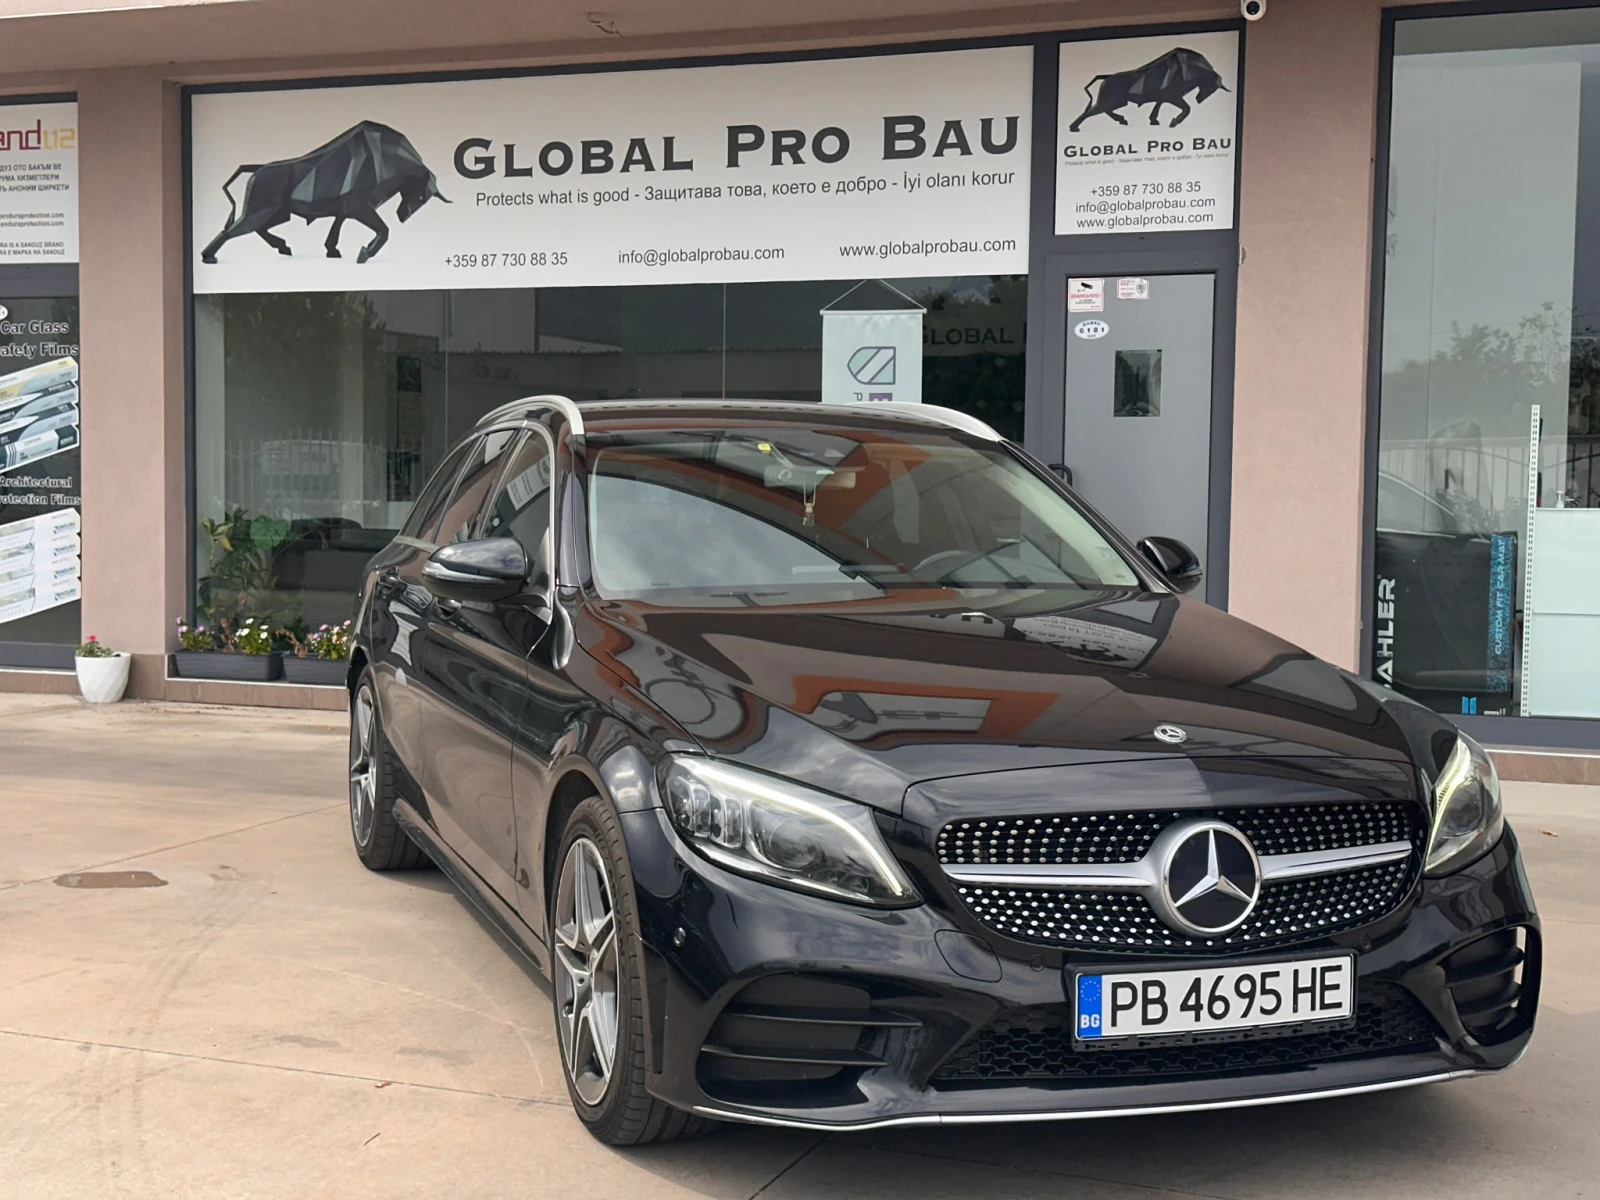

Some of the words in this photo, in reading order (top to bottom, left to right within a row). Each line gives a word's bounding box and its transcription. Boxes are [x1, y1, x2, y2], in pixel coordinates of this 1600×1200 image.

[454, 136, 694, 180] GLOBAL
[726, 124, 850, 168] PRO
[882, 114, 1020, 160] BAU
[1064, 144, 1137, 158] GLOBAL
[1148, 140, 1184, 153] PRO
[1192, 138, 1231, 150] BAU
[476, 190, 534, 207] Protects
[538, 189, 572, 204] what
[577, 189, 588, 203] is
[593, 187, 629, 206] good
[644, 186, 721, 202] Защитава
[728, 183, 766, 198] това,
[772, 180, 816, 196] което
[821, 181, 831, 193] е
[836, 176, 887, 195] добро
[972, 170, 1015, 186] korur
[1090, 185, 1119, 197] +359
[1123, 185, 1137, 196] 87
[1142, 183, 1164, 194] 730
[1167, 182, 1182, 193] 88
[1186, 182, 1201, 192] 35
[1076, 197, 1215, 214] info@globalprobau.com
[1077, 213, 1214, 229] www.globalprobau.com
[618, 247, 784, 267] info@globalprobau.com
[840, 238, 1016, 259] www.globalprobau.com
[445, 254, 477, 268] +359
[481, 254, 497, 267] 87
[502, 253, 526, 267] 730
[530, 252, 547, 266] 88
[551, 252, 568, 265] 35
[0, 320, 26, 335] Car
[28, 320, 70, 334] Glass
[40, 342, 80, 356] Films
[0, 476, 72, 488] Architectural
[50, 494, 81, 505] Films
[1498, 539, 1506, 564] MAT
[1496, 566, 1504, 589] CAR
[1376, 578, 1395, 690] AHLER
[1494, 610, 1503, 655] CUSTOM
[1110, 980, 1168, 1028] PB
[1180, 971, 1282, 1022] 4695
[1292, 964, 1343, 1013] HE
[1080, 1014, 1100, 1028] BG
